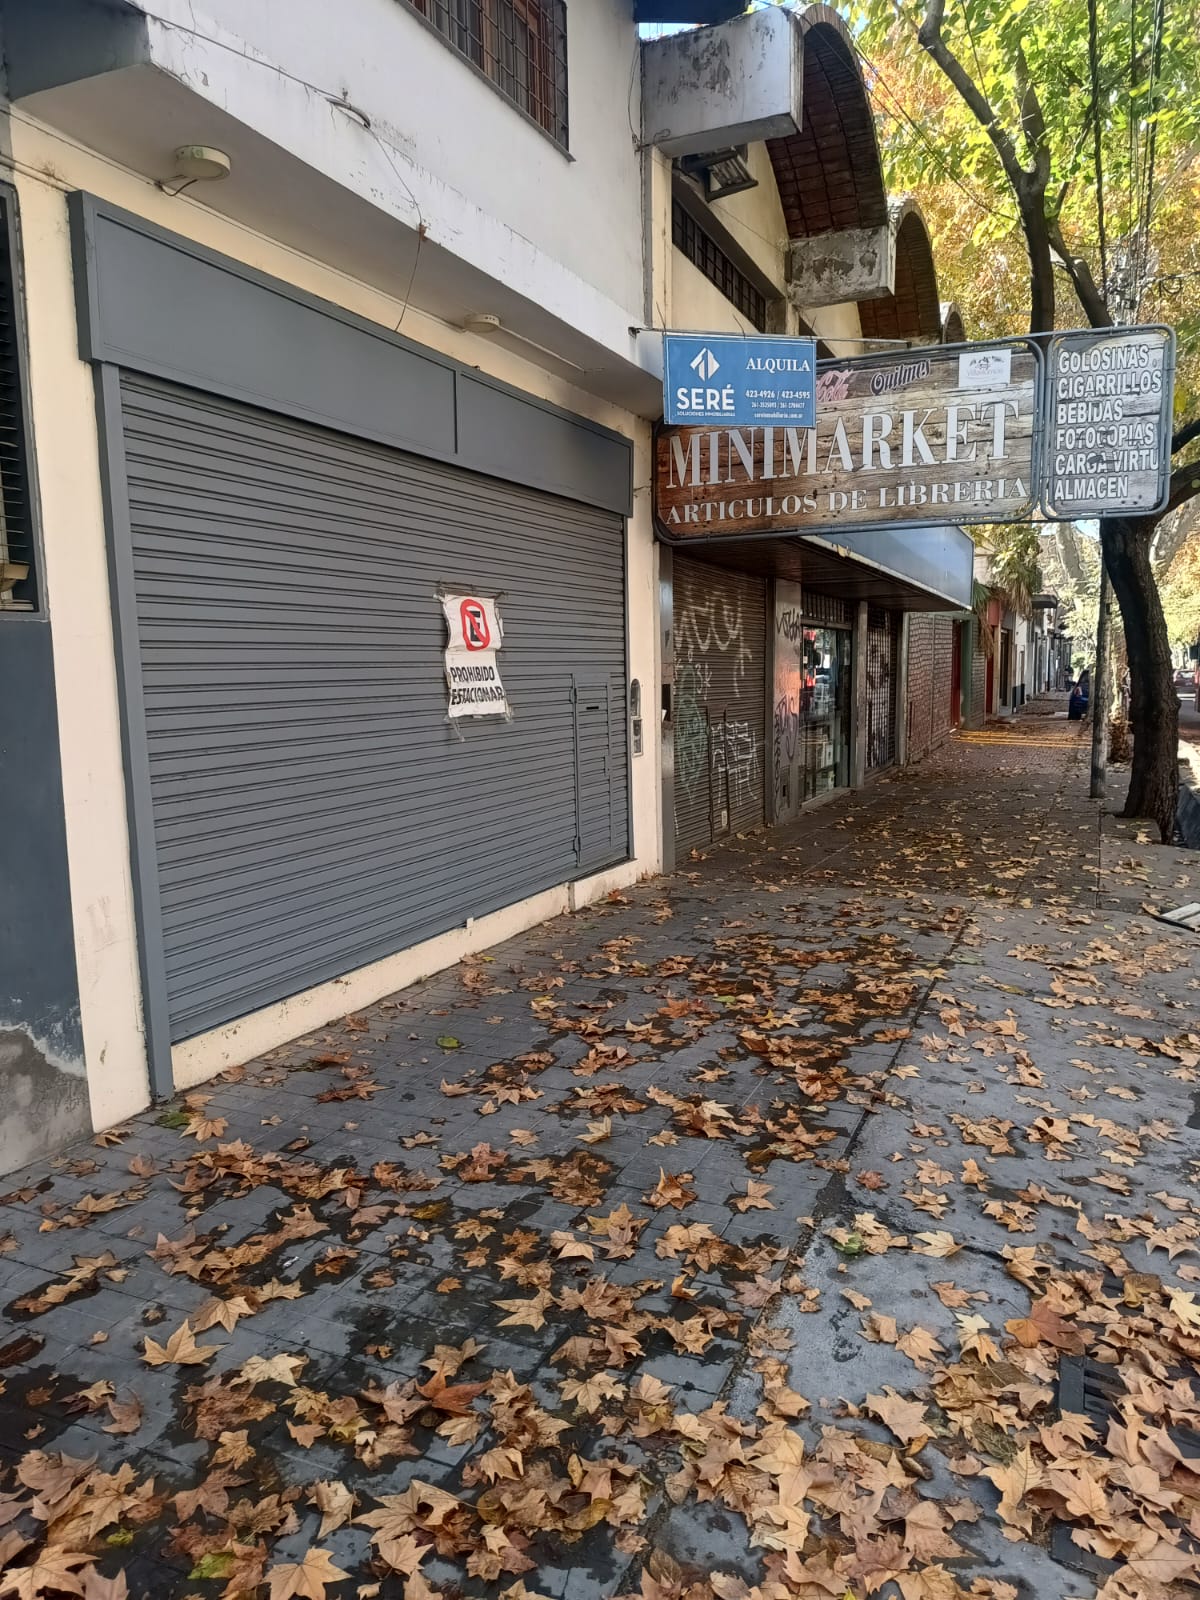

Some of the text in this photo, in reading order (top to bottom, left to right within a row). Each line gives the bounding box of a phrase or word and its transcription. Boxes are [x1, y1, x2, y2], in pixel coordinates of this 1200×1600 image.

[746, 358, 811, 373] ALQUILA
[1059, 344, 1149, 373] GOLOSINAS
[871, 359, 931, 396] Quilmes
[1058, 370, 1162, 399] CIGARRILLOS
[676, 383, 735, 410] SERÉ
[745, 389, 776, 399] 423-4926
[1057, 399, 1123, 425] BEBIDAS
[666, 400, 1019, 489] MINIMARKET
[1056, 422, 1155, 450] FOTOCOPIAS
[666, 477, 1028, 525] ARTICULOS DE LIBRERIA
[1054, 476, 1128, 500] ALMACEN
[450, 665, 495, 683] PROHIBIDO
[451, 685, 505, 705] ESTACIONAR
